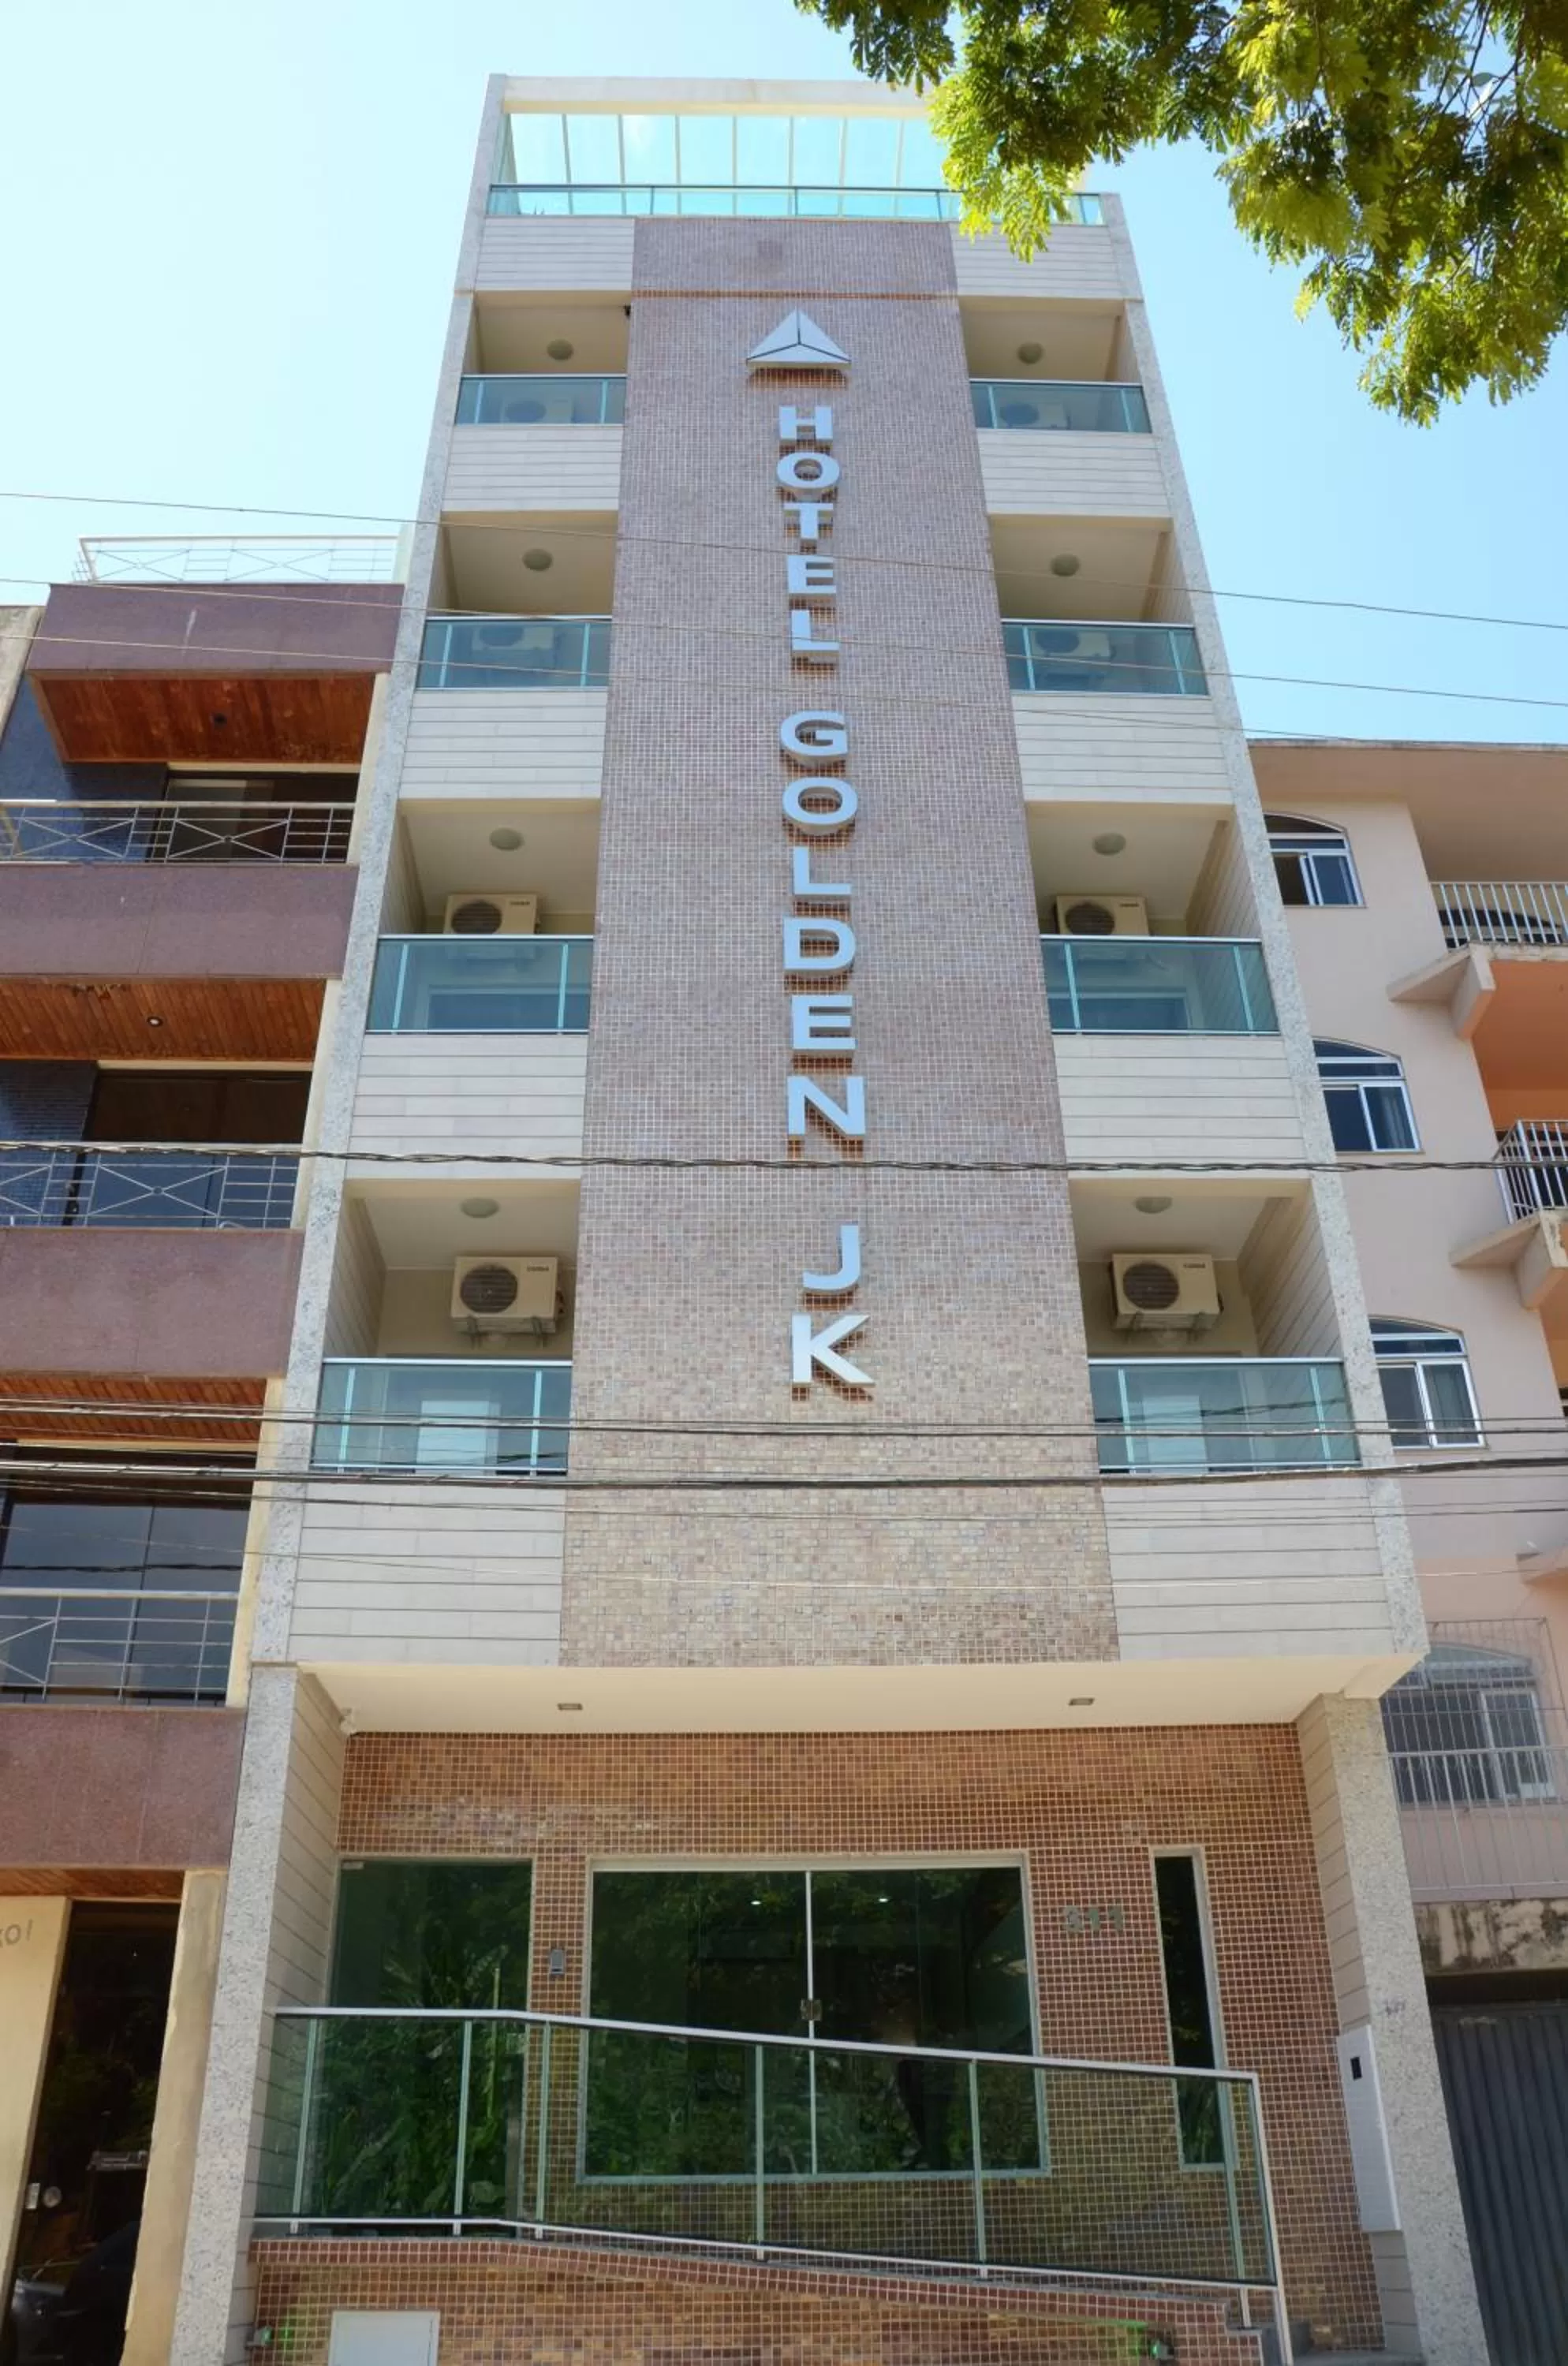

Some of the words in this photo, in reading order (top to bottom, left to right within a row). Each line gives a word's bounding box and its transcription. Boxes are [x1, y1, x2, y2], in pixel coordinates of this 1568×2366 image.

[776, 405, 841, 655] HOTEL
[779, 711, 867, 1136] GOLDEN
[791, 1225, 875, 1385] JK
[0, 1918, 33, 1948] 01
